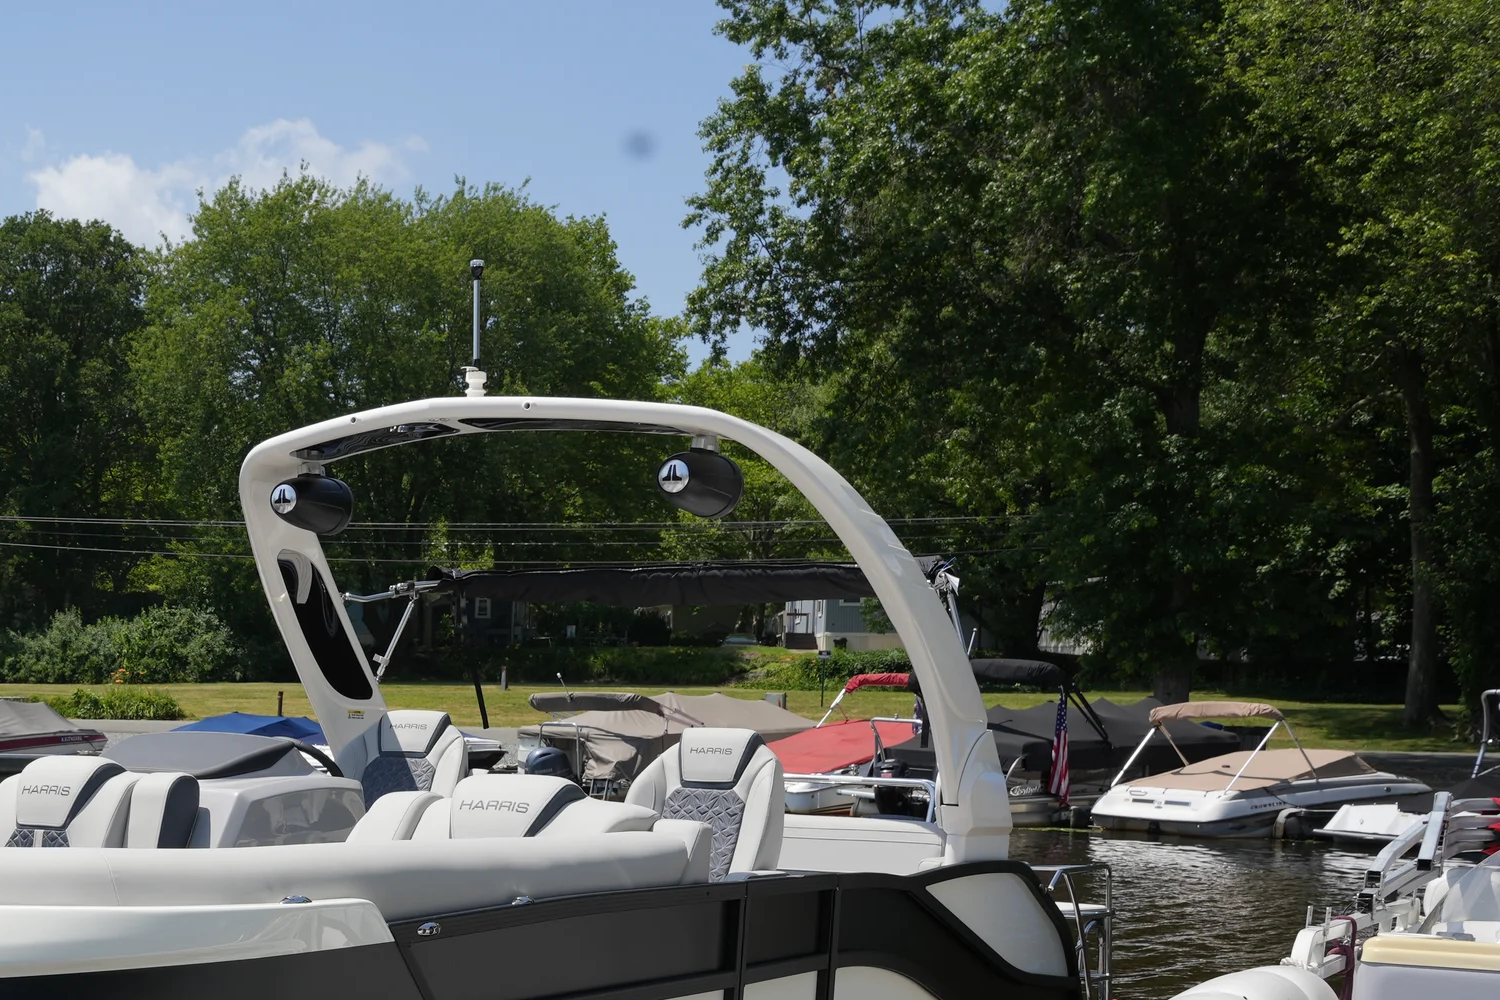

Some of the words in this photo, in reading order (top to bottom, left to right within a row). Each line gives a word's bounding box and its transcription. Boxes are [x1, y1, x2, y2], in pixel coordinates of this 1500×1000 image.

[389, 723, 428, 731] HARRIS
[690, 747, 733, 755] HARRIS
[21, 785, 71, 796] HARRIS
[459, 800, 530, 813] HARRIS
